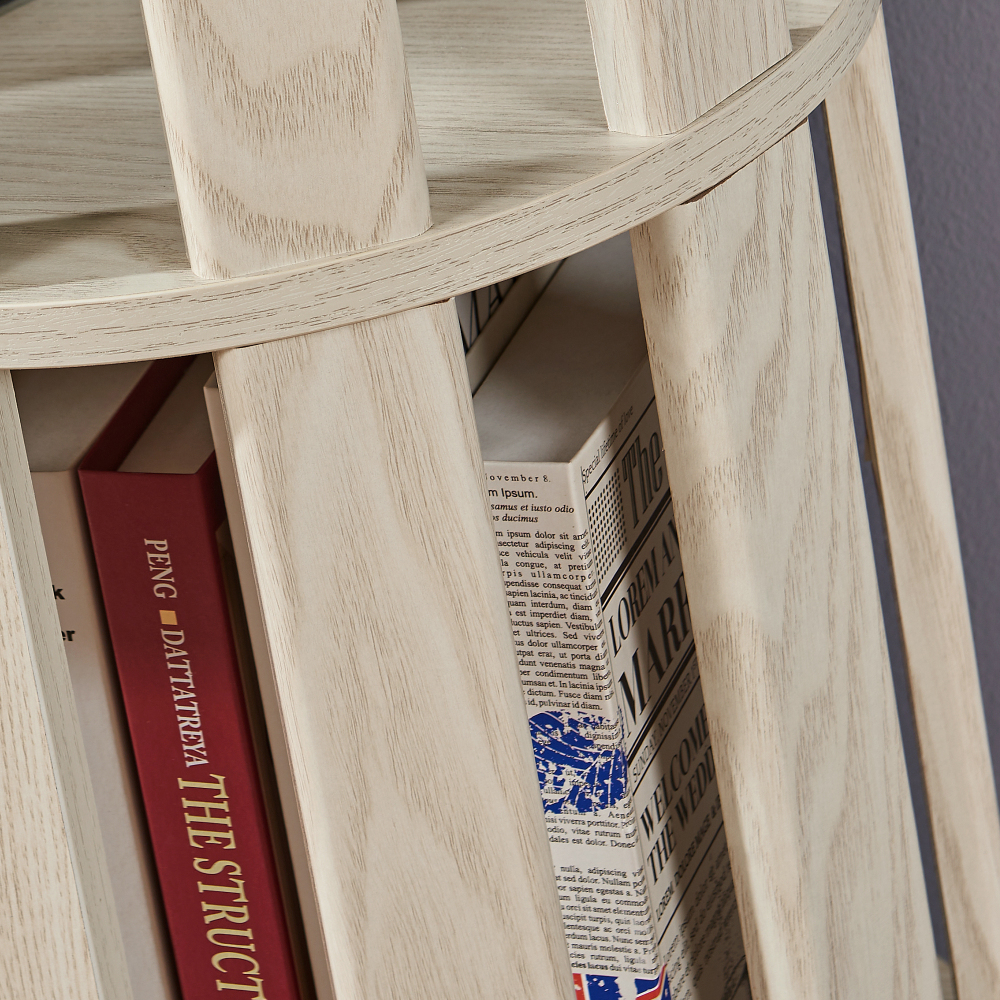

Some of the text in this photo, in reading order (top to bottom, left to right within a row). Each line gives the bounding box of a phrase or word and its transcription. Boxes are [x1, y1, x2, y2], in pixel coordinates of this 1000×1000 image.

[485, 473, 539, 482] ovember
[622, 432, 663, 530] The
[501, 488, 538, 499] Ipsum.
[531, 504, 552, 513] iusto
[554, 504, 574, 513] odio
[502, 513, 539, 523] ducimus
[507, 530, 531, 539] ipsum
[535, 530, 556, 539] dolor
[559, 532, 569, 540] sit
[535, 541, 576, 552] adipiscing
[515, 550, 549, 559] vehicula
[555, 552, 573, 560] velit
[515, 560, 547, 570] congue,
[531, 600, 568, 610] interdum,
[573, 603, 593, 611] diam
[608, 547, 660, 659] LOREM
[535, 670, 588, 680] condimentum
[144, 538, 268, 1000] PENG DATTATREYA THE STRUCT
[647, 815, 677, 885] THE
